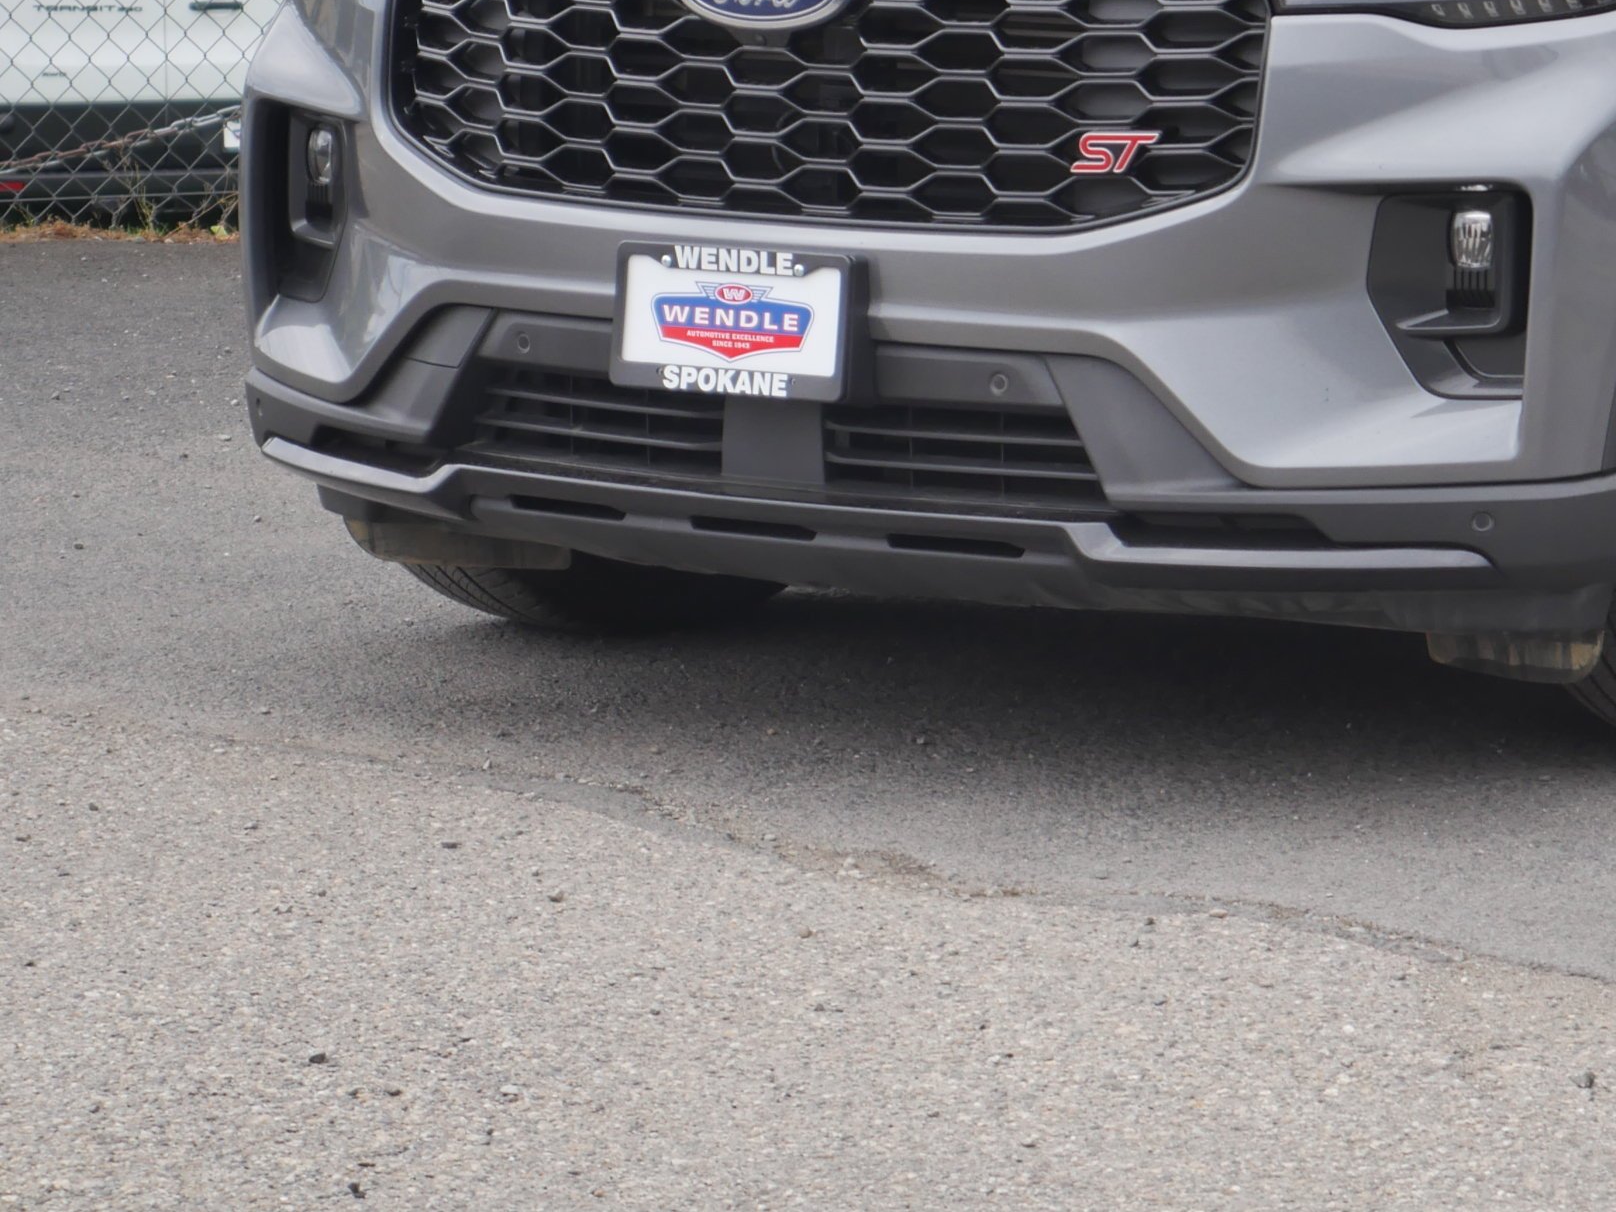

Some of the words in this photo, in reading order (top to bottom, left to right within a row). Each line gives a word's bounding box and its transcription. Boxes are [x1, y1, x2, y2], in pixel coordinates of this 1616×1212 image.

[1070, 130, 1161, 174] ST
[674, 244, 795, 277] WENDLE
[662, 304, 799, 332] WENDLE
[686, 329, 731, 340] AUTOMOTIVE
[731, 332, 775, 343] EXCELLENCE
[712, 339, 733, 348] SINCE
[662, 364, 789, 397] SPOKANE
